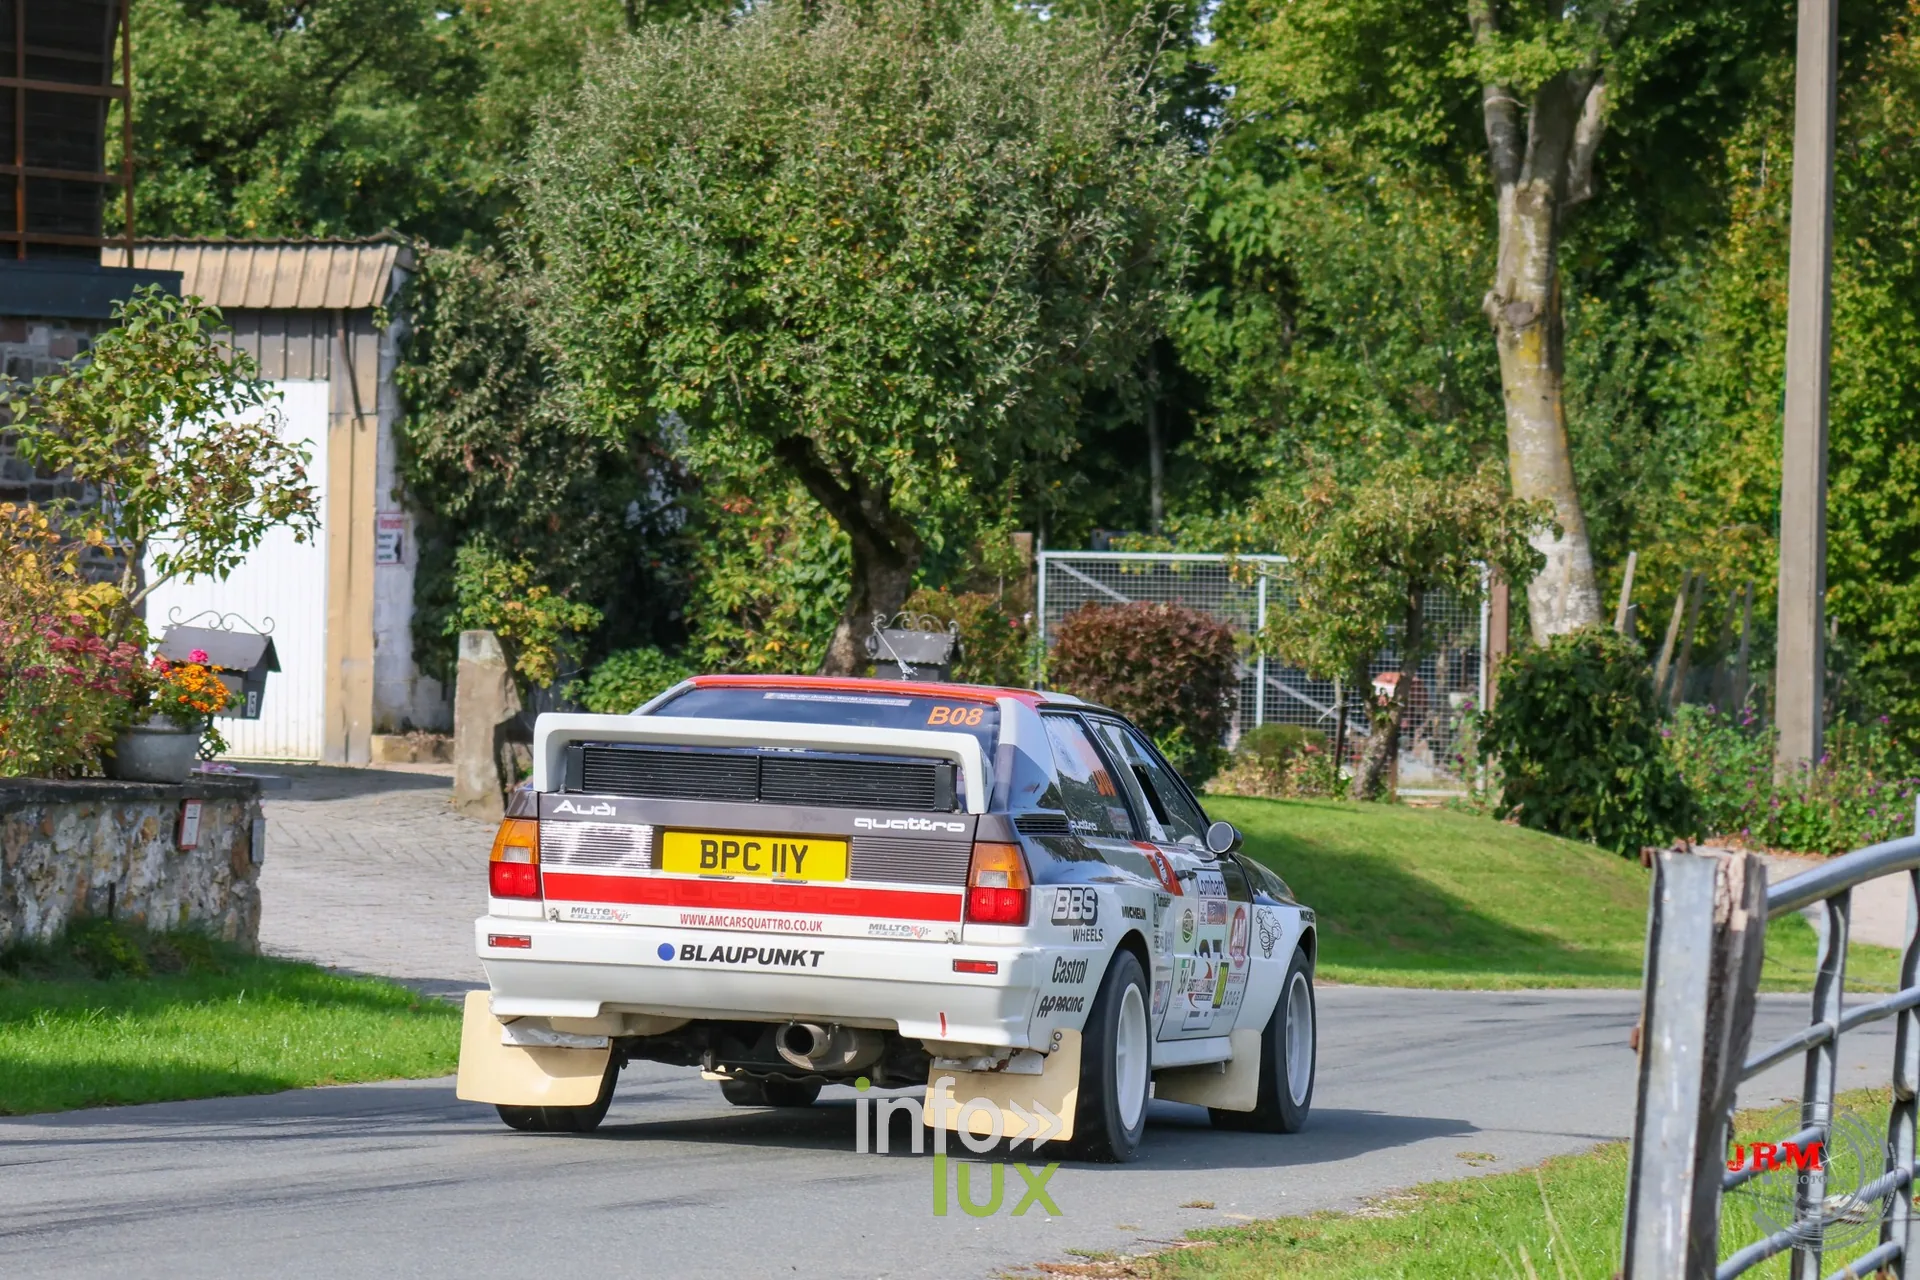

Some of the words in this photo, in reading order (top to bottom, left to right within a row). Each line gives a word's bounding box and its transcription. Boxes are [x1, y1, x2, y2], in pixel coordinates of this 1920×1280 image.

[928, 706, 984, 727] B08
[553, 800, 616, 816] Audi
[854, 817, 965, 833] quattro
[700, 839, 762, 871] BPC
[1051, 887, 1099, 926] BBS
[680, 913, 823, 932] WWW.AMCARSQUATTRO.CO.UK
[1072, 929, 1104, 942] WHEELS
[679, 944, 825, 967] BLAUPUNKT
[1052, 956, 1089, 984] Castrol
[1054, 996, 1085, 1013] RACING
